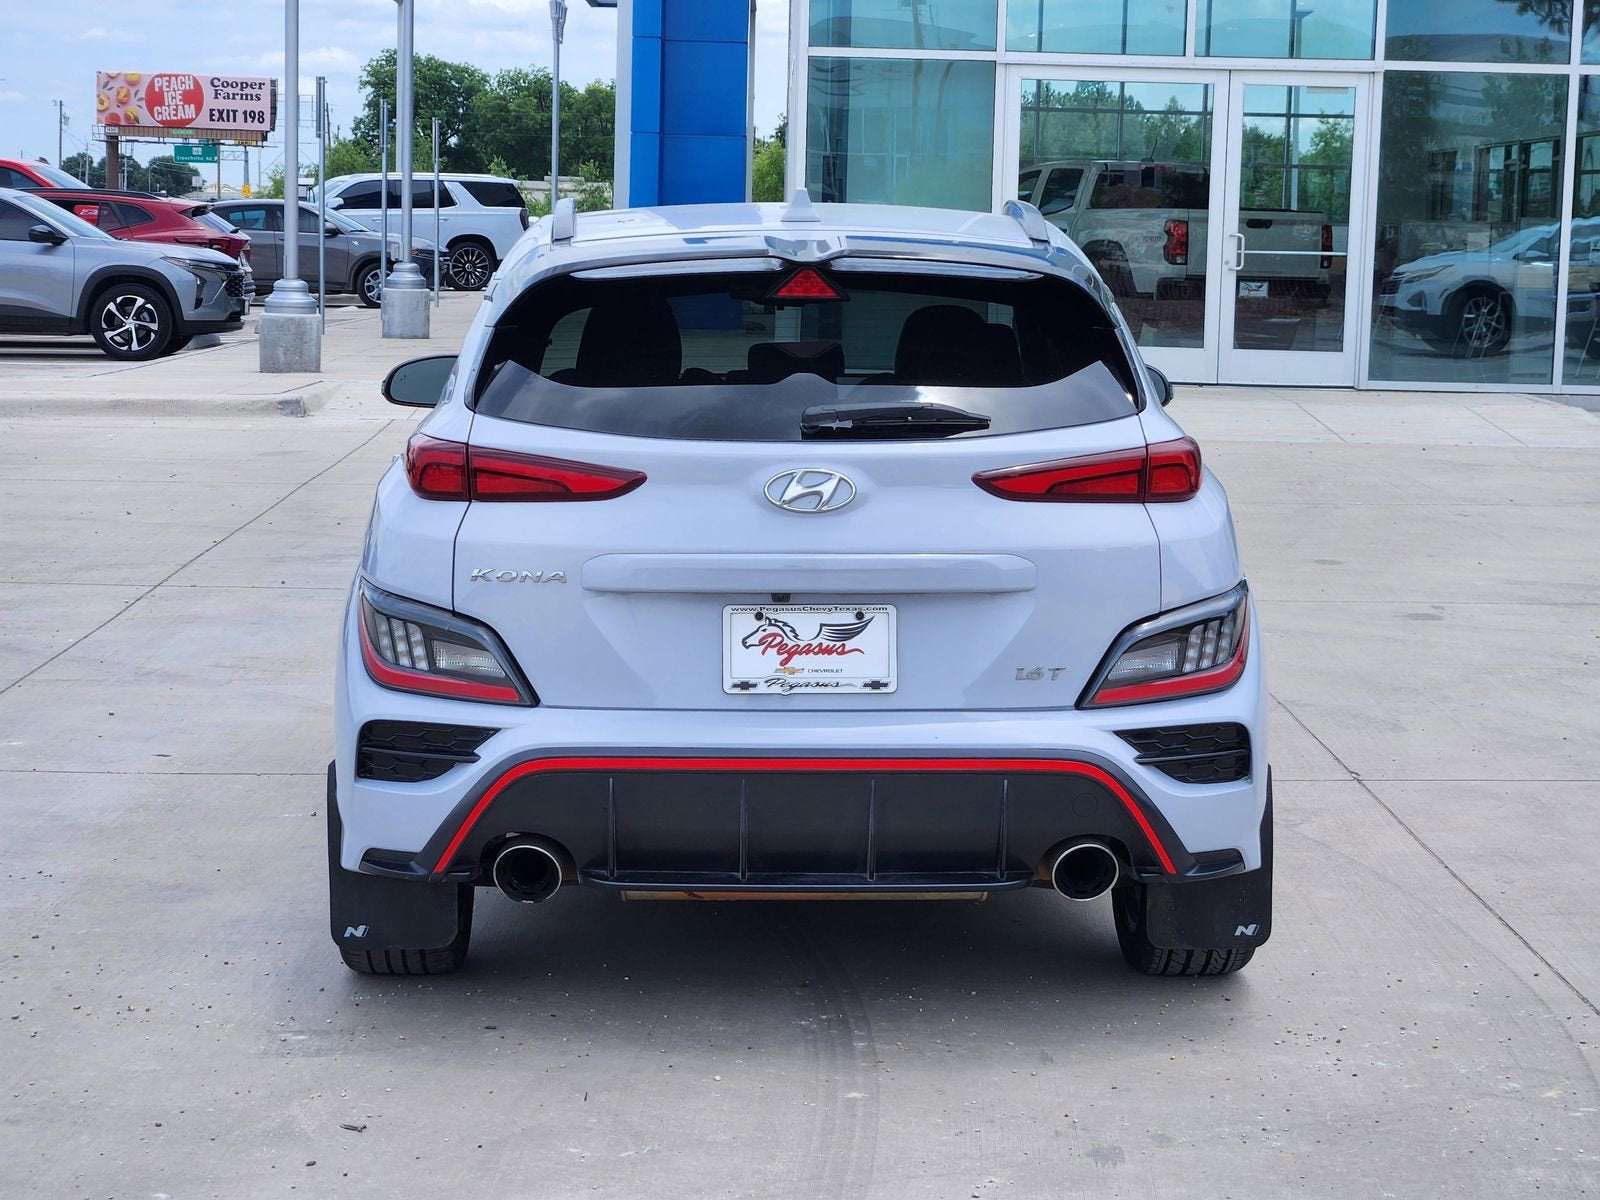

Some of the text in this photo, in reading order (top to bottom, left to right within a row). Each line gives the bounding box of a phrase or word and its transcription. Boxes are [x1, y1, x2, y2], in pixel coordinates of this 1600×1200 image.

[154, 76, 194, 91] PEACH
[210, 77, 265, 92] Cooper
[164, 91, 184, 106] ICE
[213, 89, 262, 101] Farms
[154, 104, 195, 120] CREAM
[209, 108, 265, 124] EXIT 198
[470, 568, 567, 583] KONA
[758, 632, 864, 667] Pegasus
[764, 678, 858, 692] Pegasus
